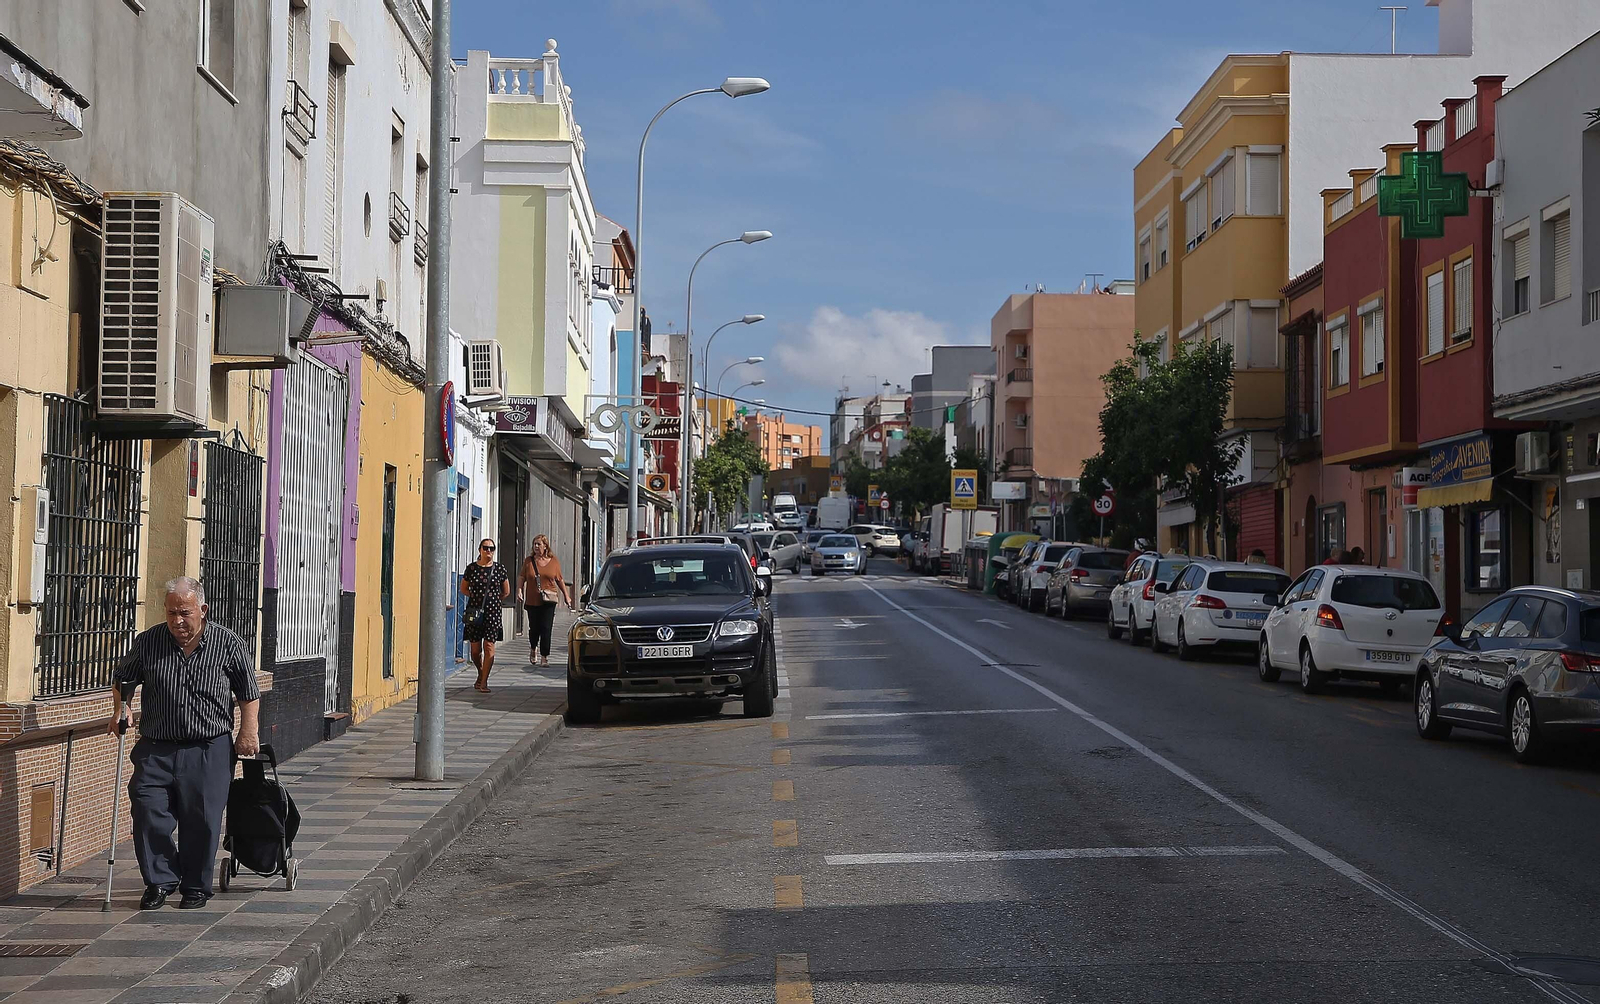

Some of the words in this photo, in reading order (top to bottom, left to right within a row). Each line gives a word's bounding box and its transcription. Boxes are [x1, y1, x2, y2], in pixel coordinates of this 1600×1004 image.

[507, 397, 537, 406] TIVISION
[512, 423, 536, 433] Bajadilla
[1457, 439, 1491, 468] AVENIDA
[1409, 473, 1431, 482] AGF
[1096, 500, 1111, 509] 30
[644, 647, 669, 657] 2216
[672, 646, 691, 656] GFR
[1371, 651, 1393, 661] 3599
[1394, 653, 1411, 662] GTD
